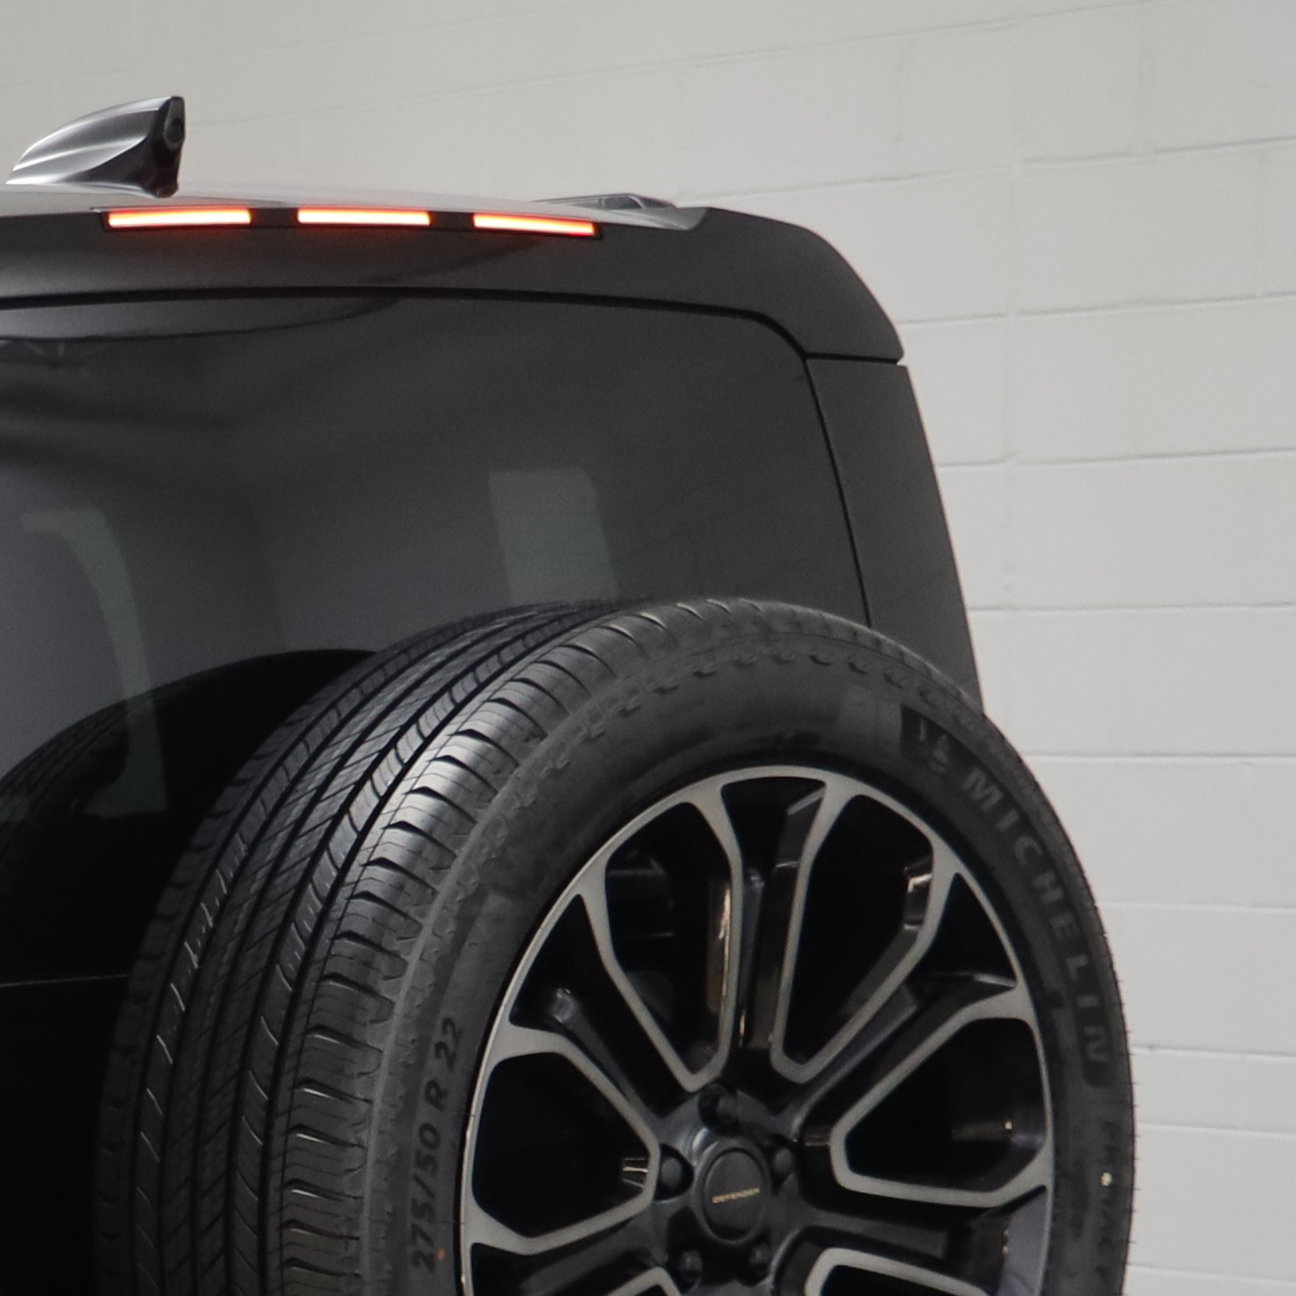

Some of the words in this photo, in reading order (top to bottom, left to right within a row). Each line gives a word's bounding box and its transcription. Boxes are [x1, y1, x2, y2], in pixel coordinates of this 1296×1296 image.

[962, 766, 1110, 1063] MICHELIN
[424, 1077, 449, 1114] R
[433, 1016, 463, 1073] 22
[410, 1121, 442, 1274] 275/50
